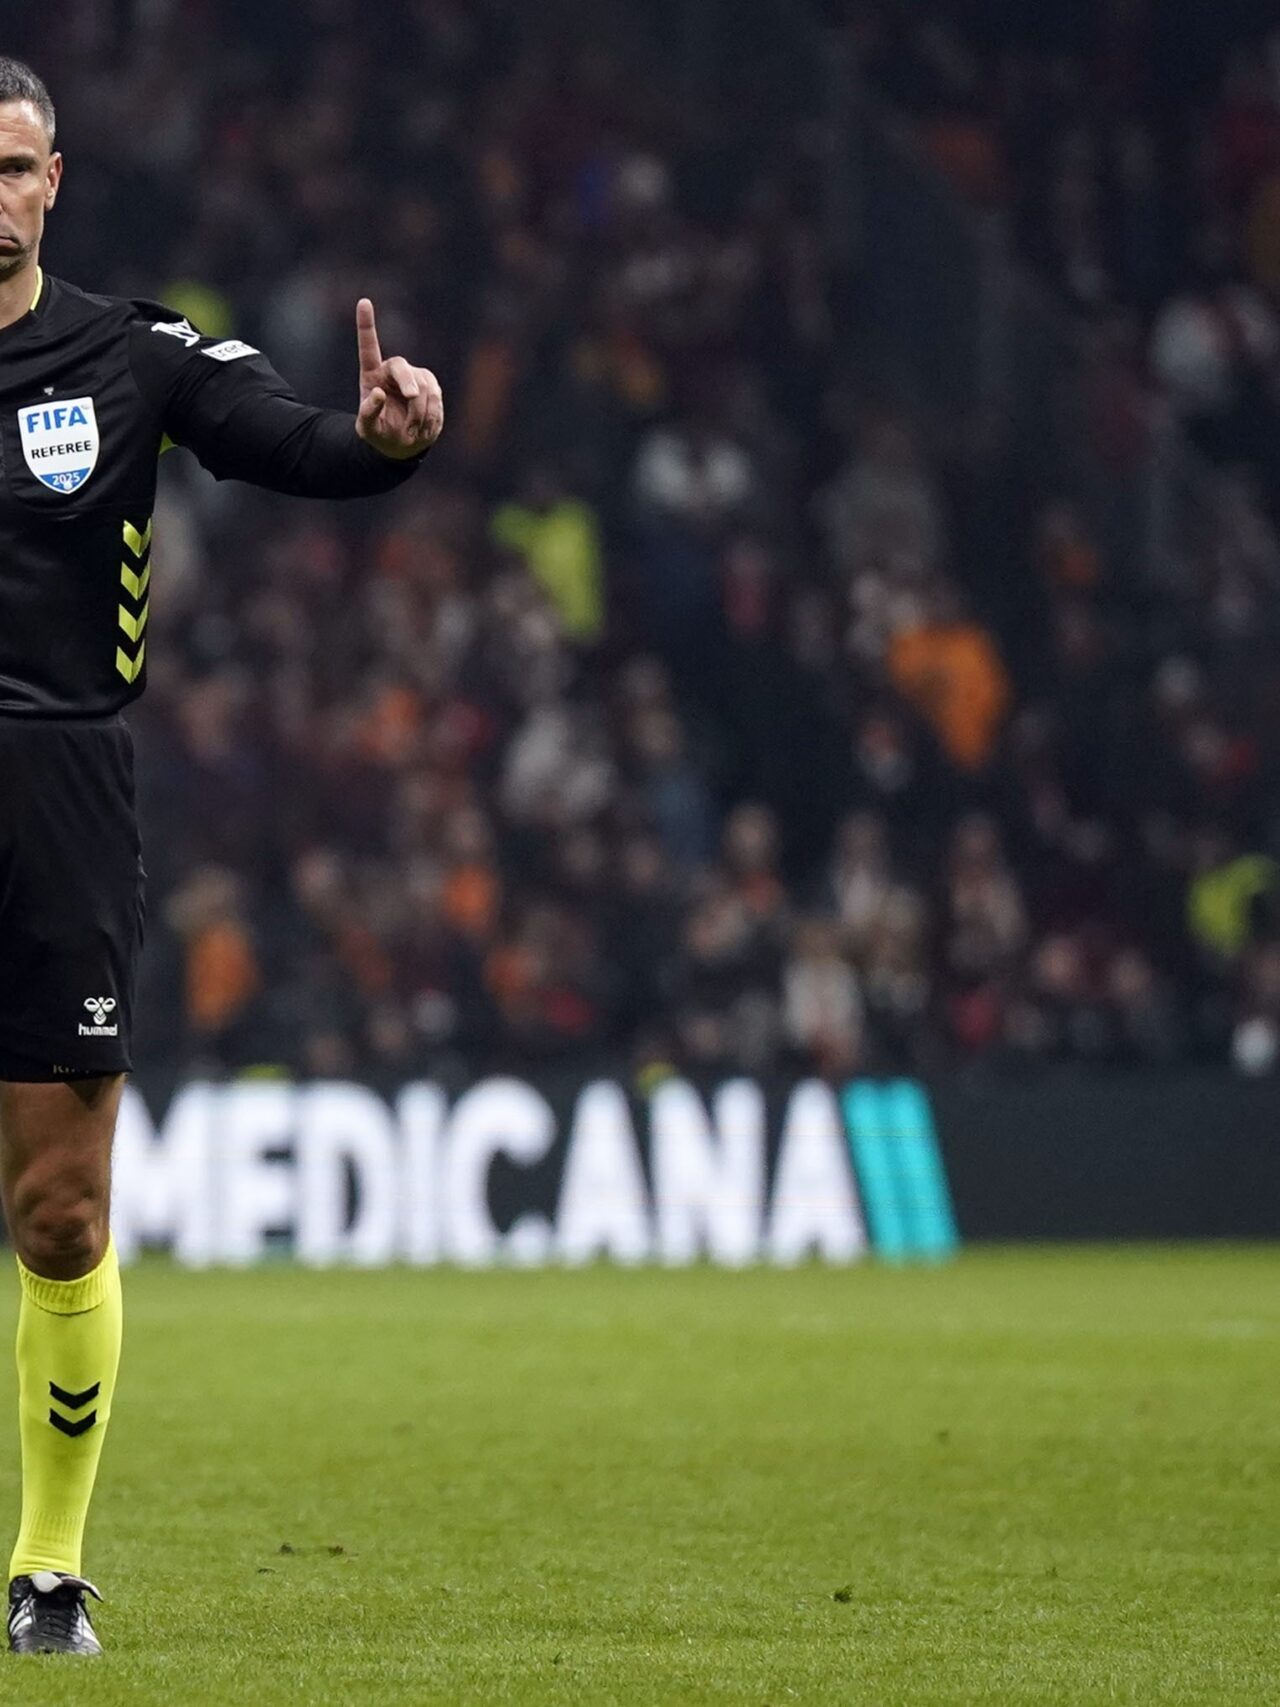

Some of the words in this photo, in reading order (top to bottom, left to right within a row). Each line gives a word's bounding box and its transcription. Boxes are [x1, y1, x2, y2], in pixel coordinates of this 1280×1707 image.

[27, 406, 87, 433] FIFA
[31, 441, 92, 459] REFEREE
[52, 472, 81, 485] 2025
[78, 1023, 118, 1036] hummel
[111, 1077, 867, 1269] MEDICANA
